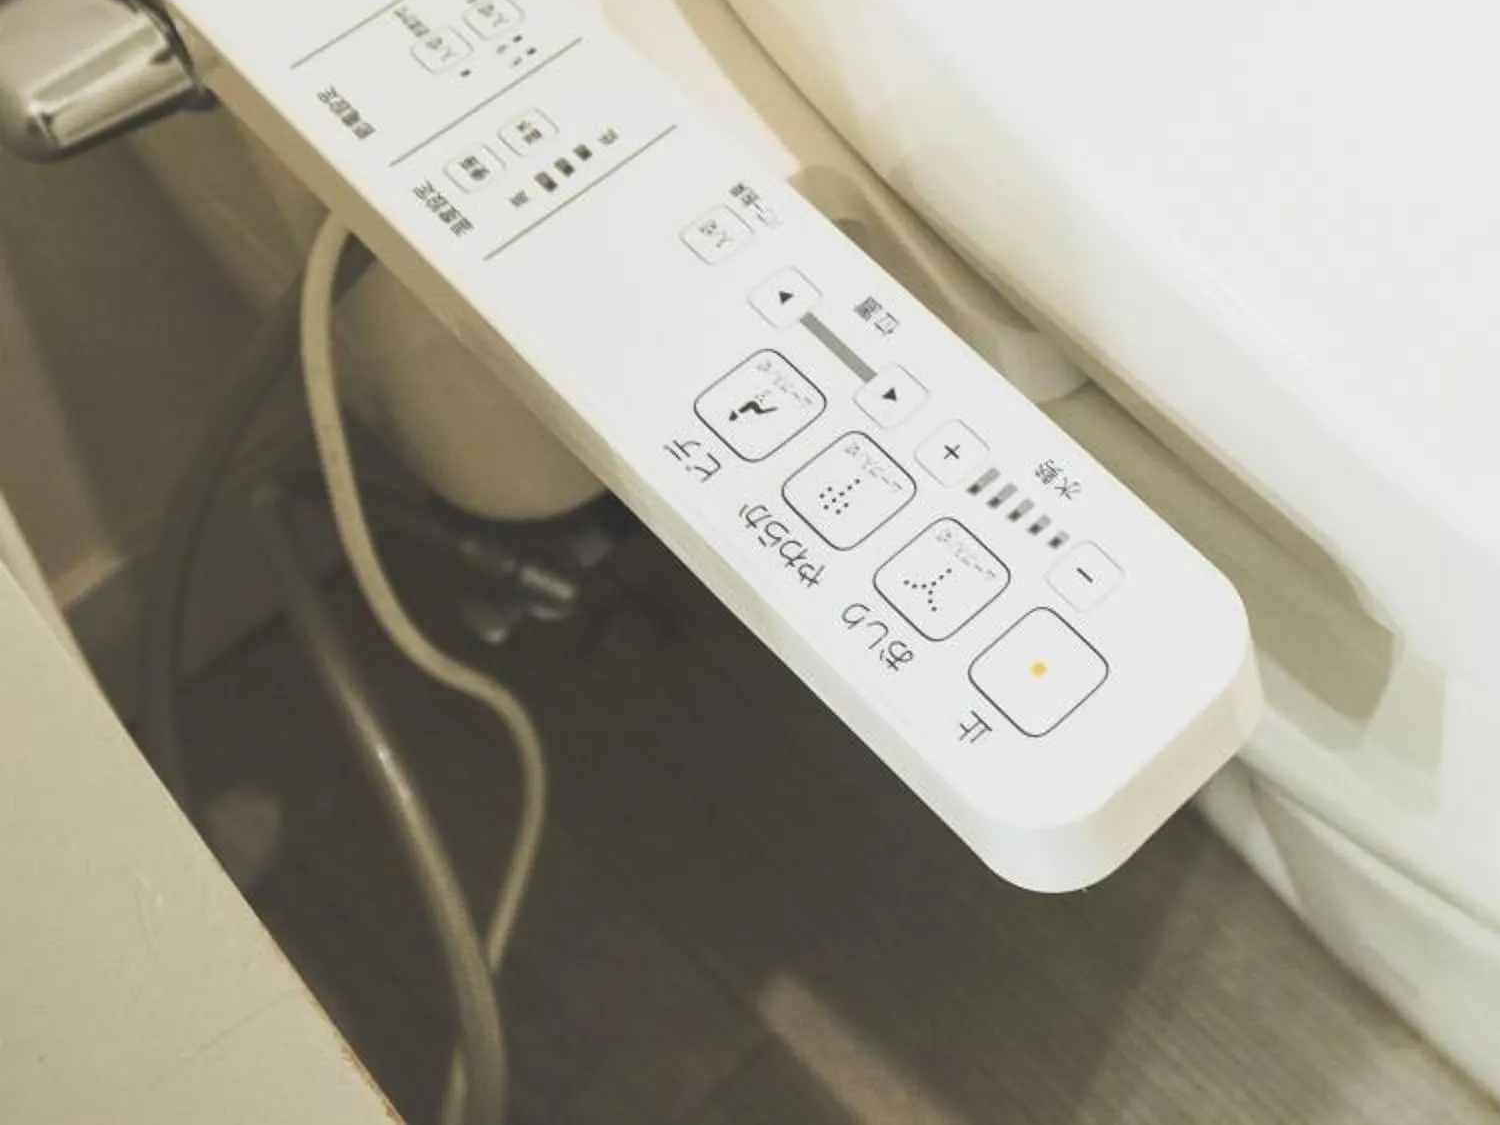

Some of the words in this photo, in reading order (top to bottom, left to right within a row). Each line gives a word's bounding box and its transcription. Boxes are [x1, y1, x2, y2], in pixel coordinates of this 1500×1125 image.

[854, 296, 899, 337] 位置
[662, 438, 723, 483] ビデ
[1035, 459, 1081, 501] 水勢
[739, 503, 824, 588] やわらか
[841, 602, 914, 671] おしり
[959, 710, 992, 744] 止
